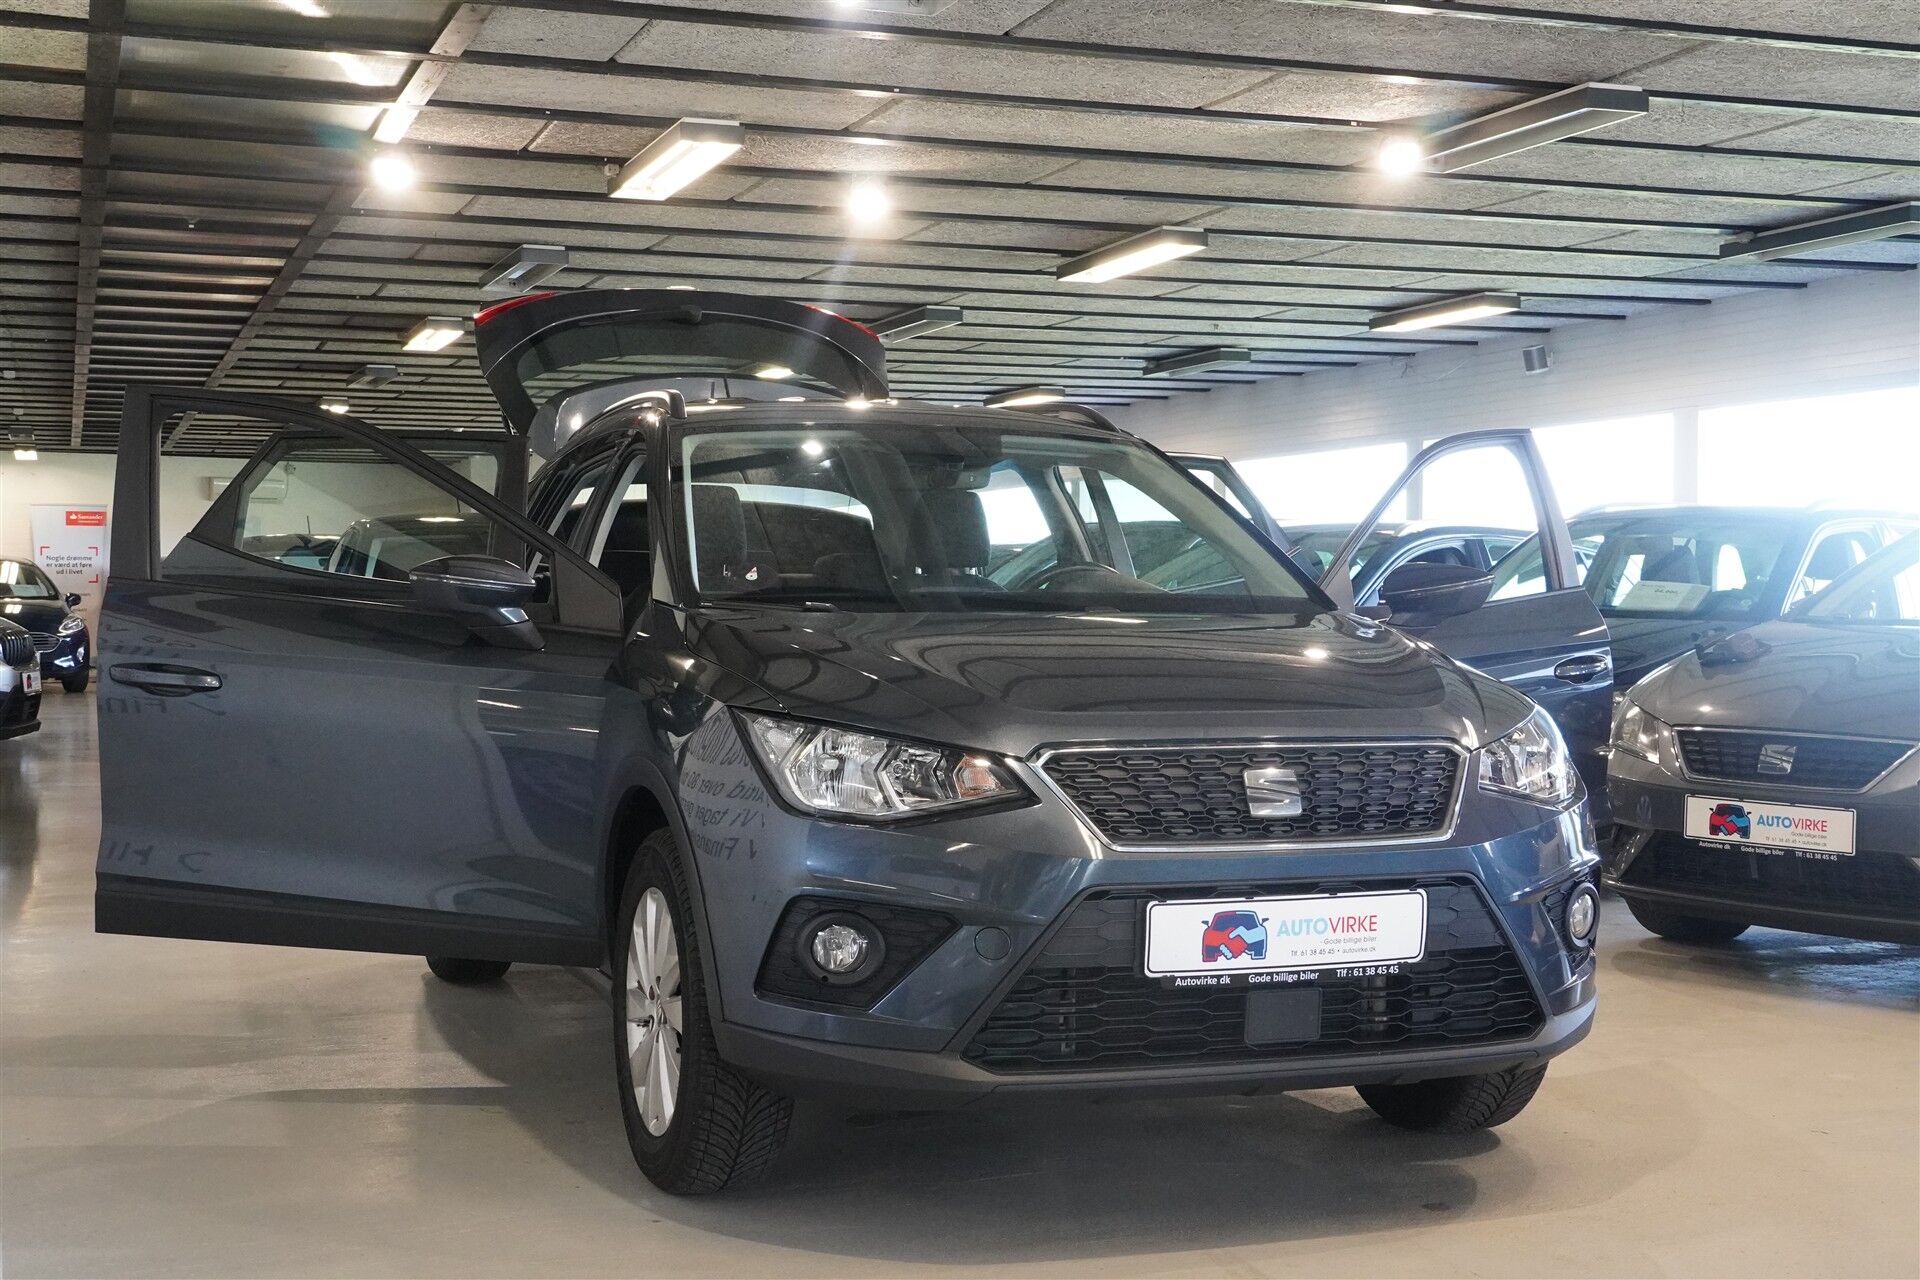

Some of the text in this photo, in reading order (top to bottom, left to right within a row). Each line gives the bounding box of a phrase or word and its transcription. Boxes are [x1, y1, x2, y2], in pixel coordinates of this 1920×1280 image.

[1756, 814, 1828, 832] AUTOVIRKE
[1699, 841, 1724, 850] Autovirke
[1740, 845, 1754, 853] Gode
[1756, 846, 1772, 855] billige
[1276, 914, 1378, 937] AUTOVIRKE
[1343, 936, 1362, 946] billige
[1342, 946, 1377, 954] autovirke.dk
[1336, 969, 1348, 978] Tlf
[1353, 968, 1364, 977] 61
[1365, 967, 1376, 976] 38
[1376, 966, 1388, 976] 45
[1388, 965, 1399, 974] 45
[1174, 976, 1230, 986] Autovirke dk
[1248, 971, 1319, 983] Gode billige biler
